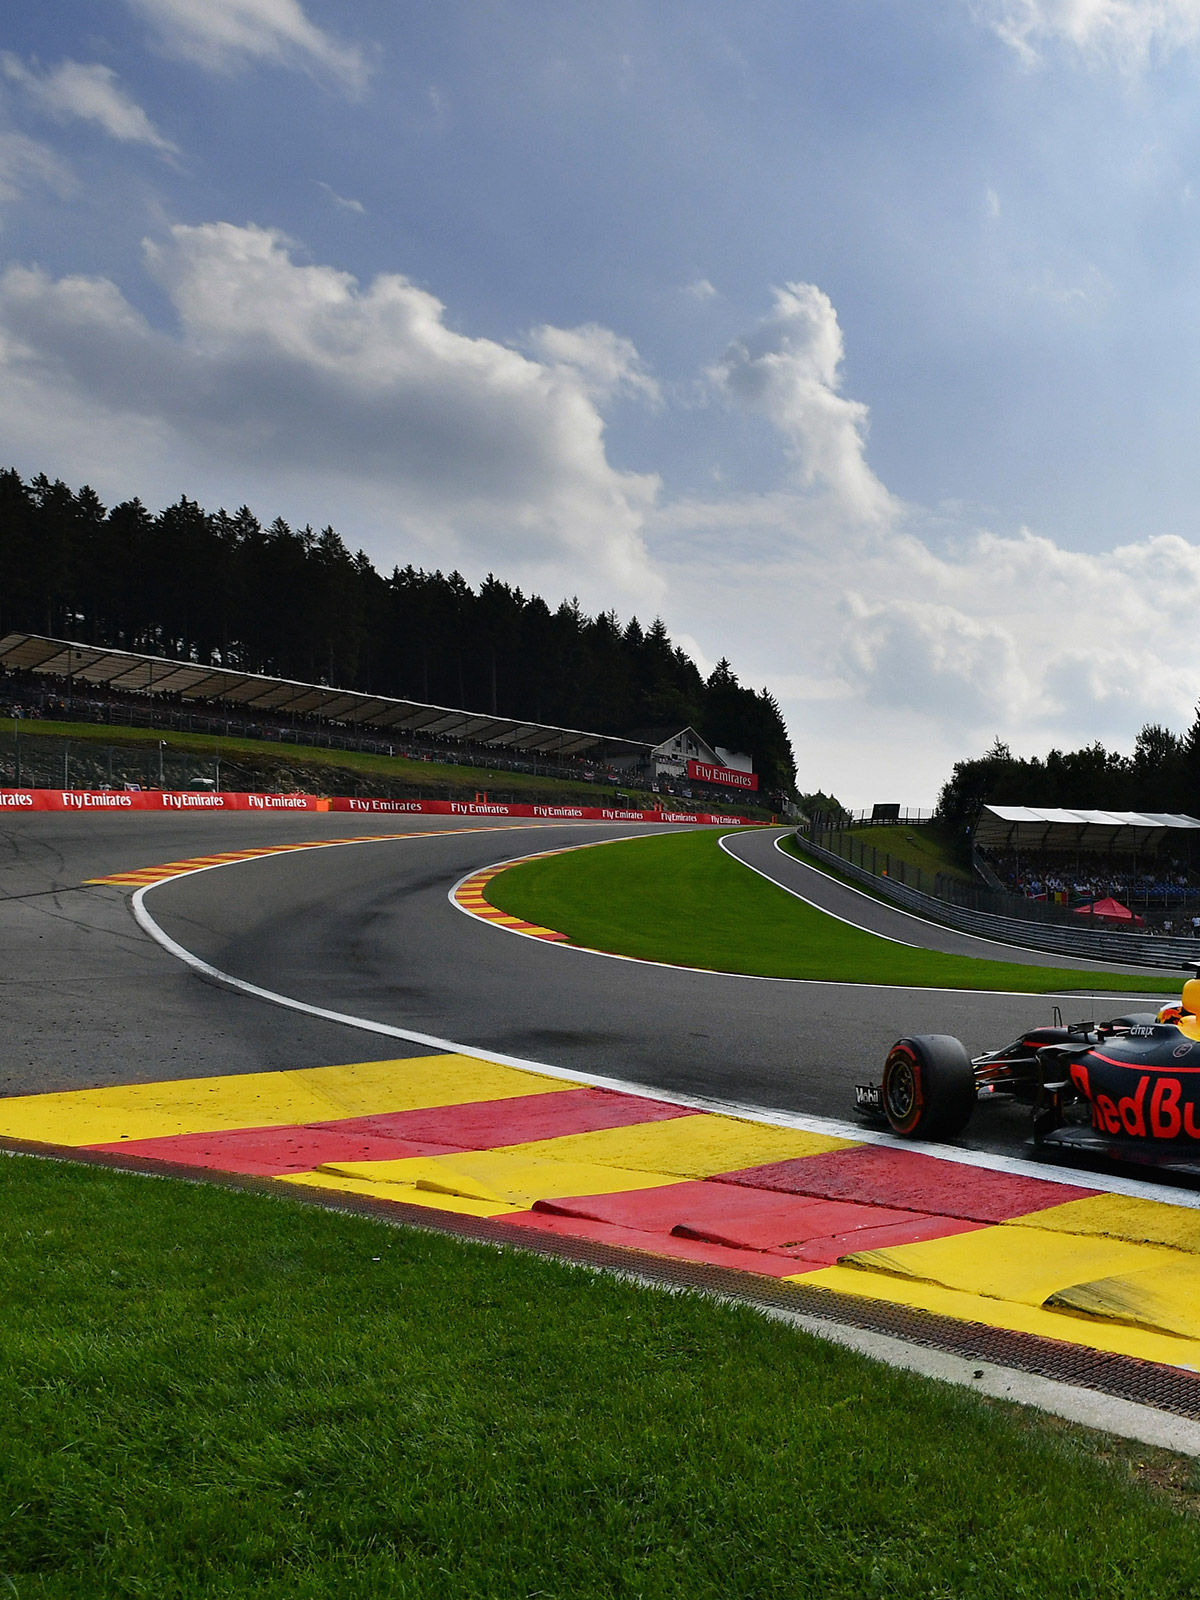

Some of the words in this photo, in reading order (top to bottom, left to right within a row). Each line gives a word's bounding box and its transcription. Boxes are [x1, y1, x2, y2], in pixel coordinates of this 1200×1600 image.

[695, 765, 712, 781] Fly
[713, 768, 752, 787] Emirates
[62, 793, 83, 808] Fly
[84, 793, 131, 806] Emirates
[162, 794, 182, 808] Fly
[183, 794, 224, 806] Emirates
[248, 795, 264, 809] Fly
[265, 796, 307, 807] Emirates
[349, 799, 370, 811] Fly
[372, 800, 422, 811] Emirates
[451, 803, 467, 814] Fly
[469, 803, 509, 814] Emirates
[533, 806, 548, 817] Fly
[548, 807, 583, 817] Emirates
[602, 809, 614, 820] Fly
[614, 810, 644, 820] Emirates
